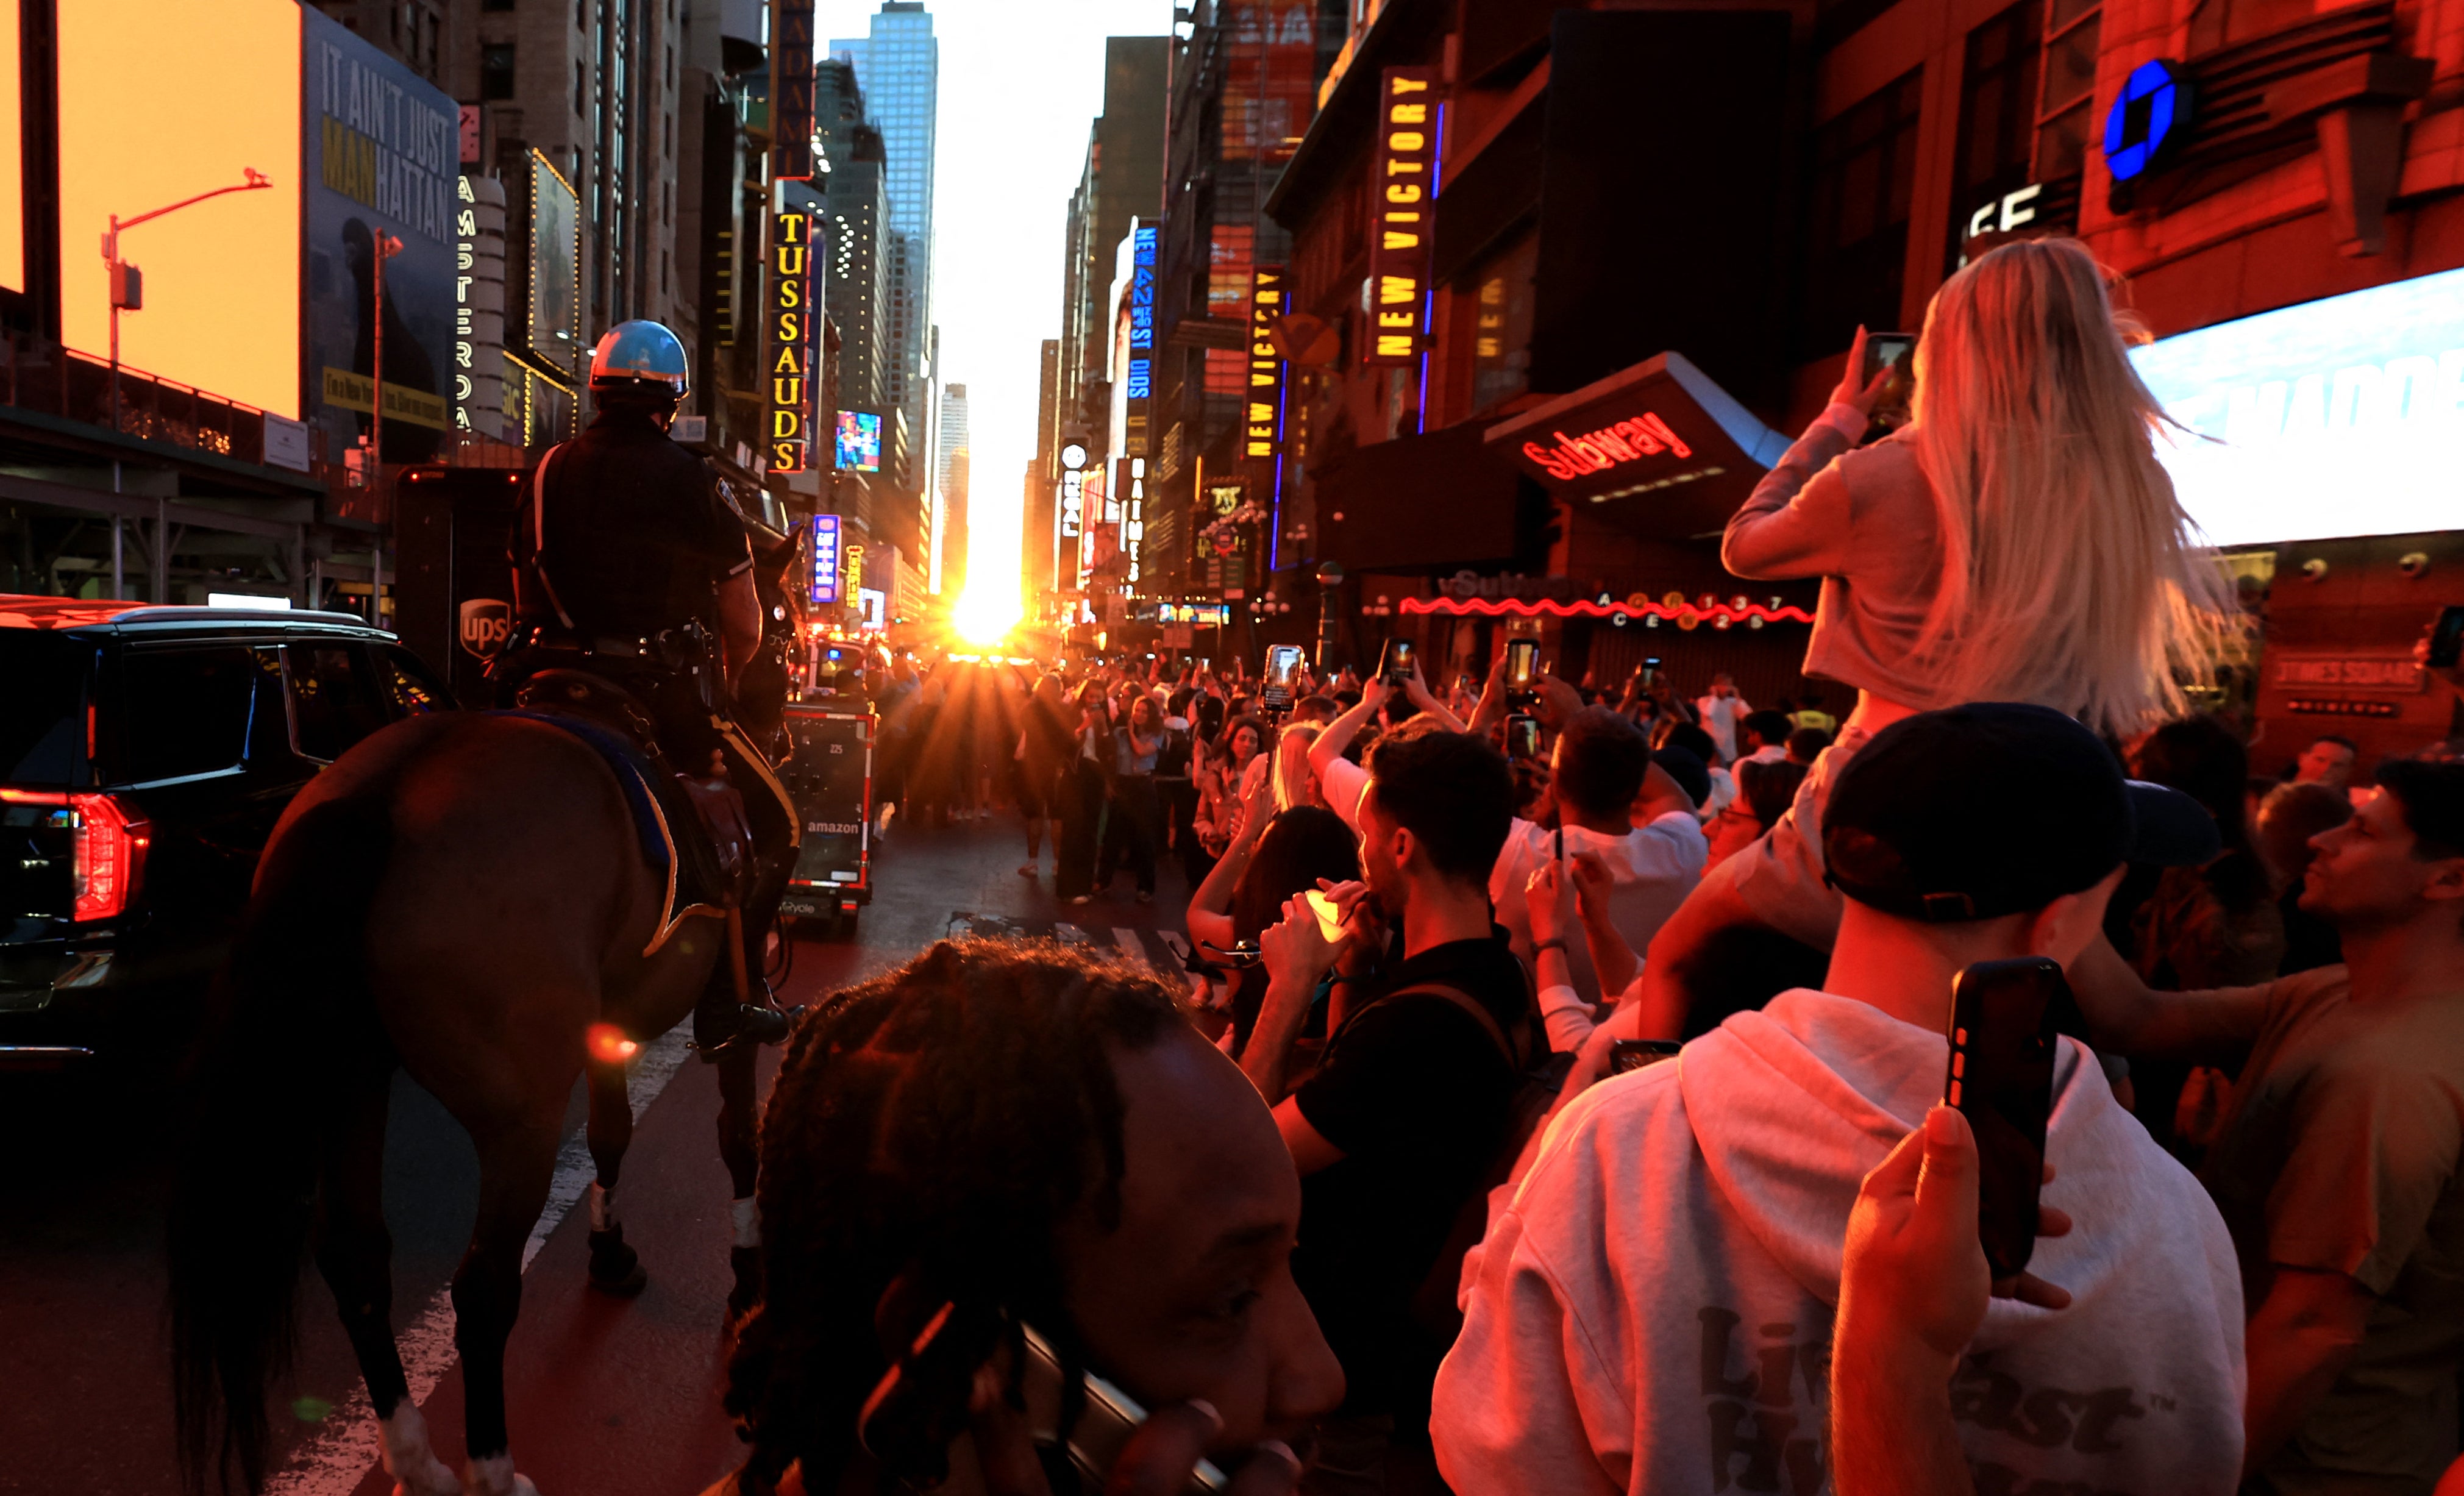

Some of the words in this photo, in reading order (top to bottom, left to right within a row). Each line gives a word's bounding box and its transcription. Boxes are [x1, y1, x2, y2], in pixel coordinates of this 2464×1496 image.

[322, 40, 342, 117] IT
[349, 60, 404, 153] AIN'T
[408, 95, 449, 179] JUST
[322, 113, 449, 244] MANHATTAN
[1383, 76, 1428, 250] VICTORY
[1135, 227, 1157, 266] NEW
[456, 176, 476, 446] AMSTERDA
[773, 214, 803, 470] TUSSAUD'S
[1377, 276, 1416, 357] NEW
[1248, 402, 1273, 456] NEW
[1523, 411, 1692, 480] Subway
[464, 618, 507, 650] ups
[1597, 592, 1611, 607] A
[1735, 596, 1748, 611] 3
[1770, 596, 1782, 611] 7
[1613, 612, 1626, 627] C
[1646, 613, 1659, 628] E
[1716, 613, 1730, 629] 2
[808, 822, 859, 834] amazon
[1953, 1349, 2146, 1455] ast
